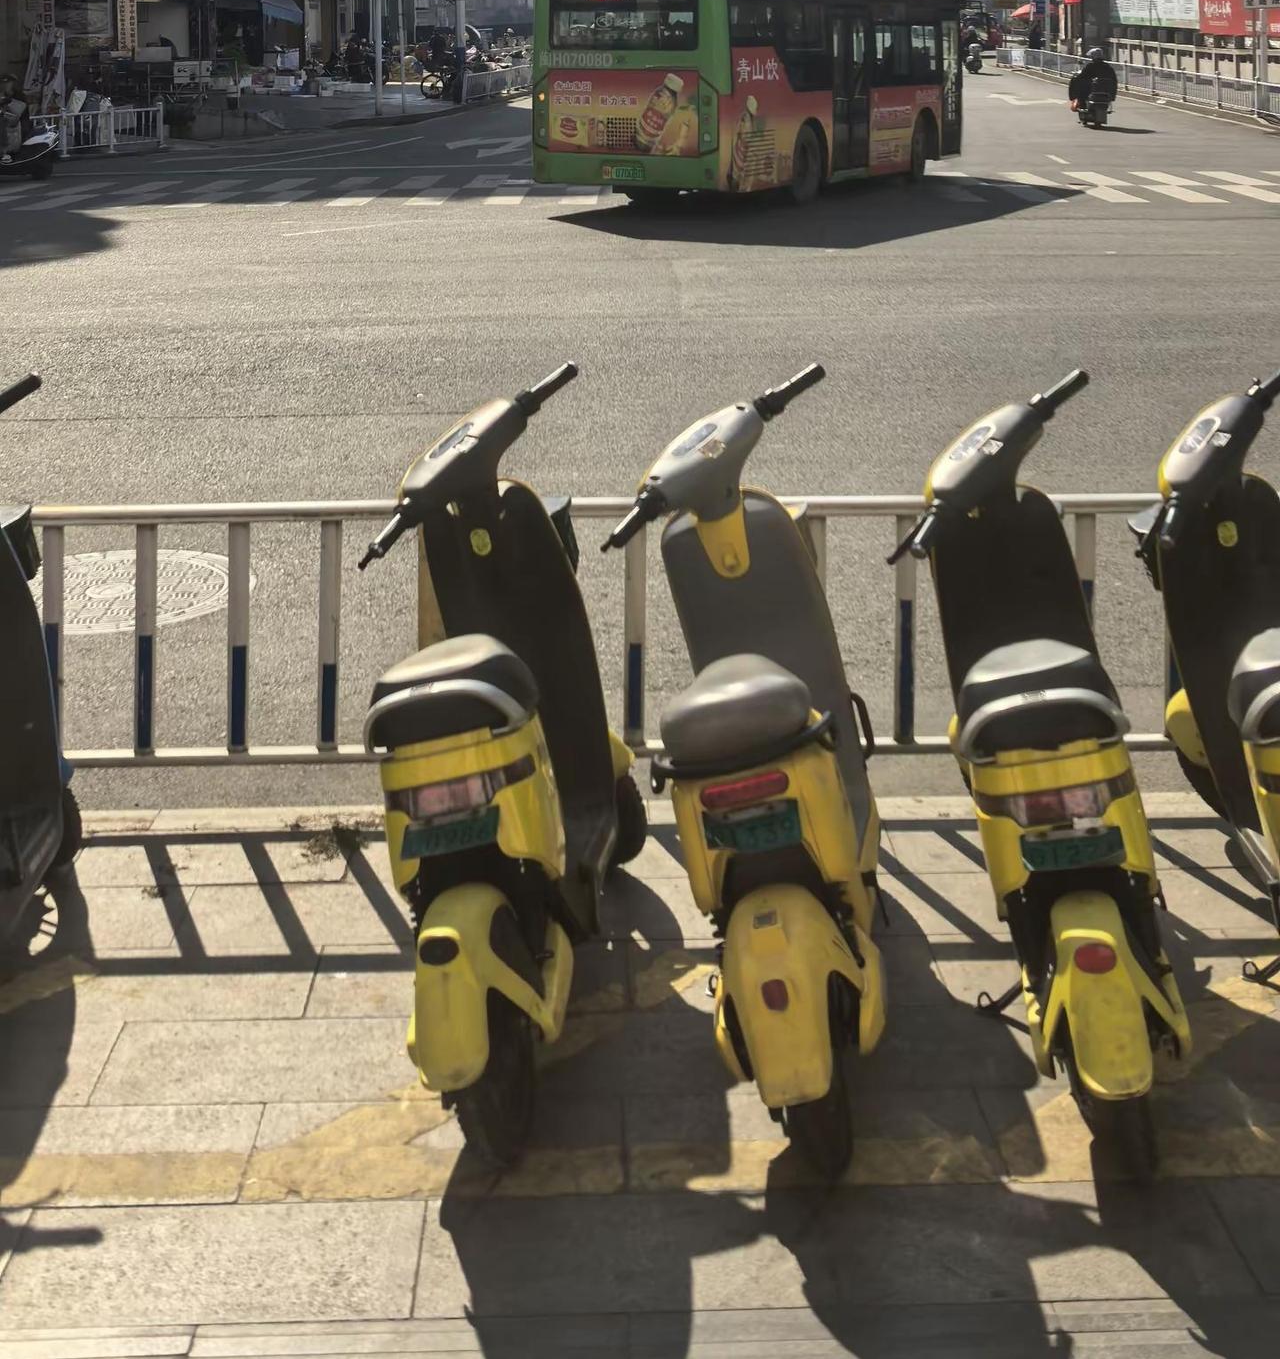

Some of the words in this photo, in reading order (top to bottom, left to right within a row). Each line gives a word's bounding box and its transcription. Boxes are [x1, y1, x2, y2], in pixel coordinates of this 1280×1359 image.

[538, 50, 613, 68] 闽H07008D
[736, 57, 780, 83] 青山饮
